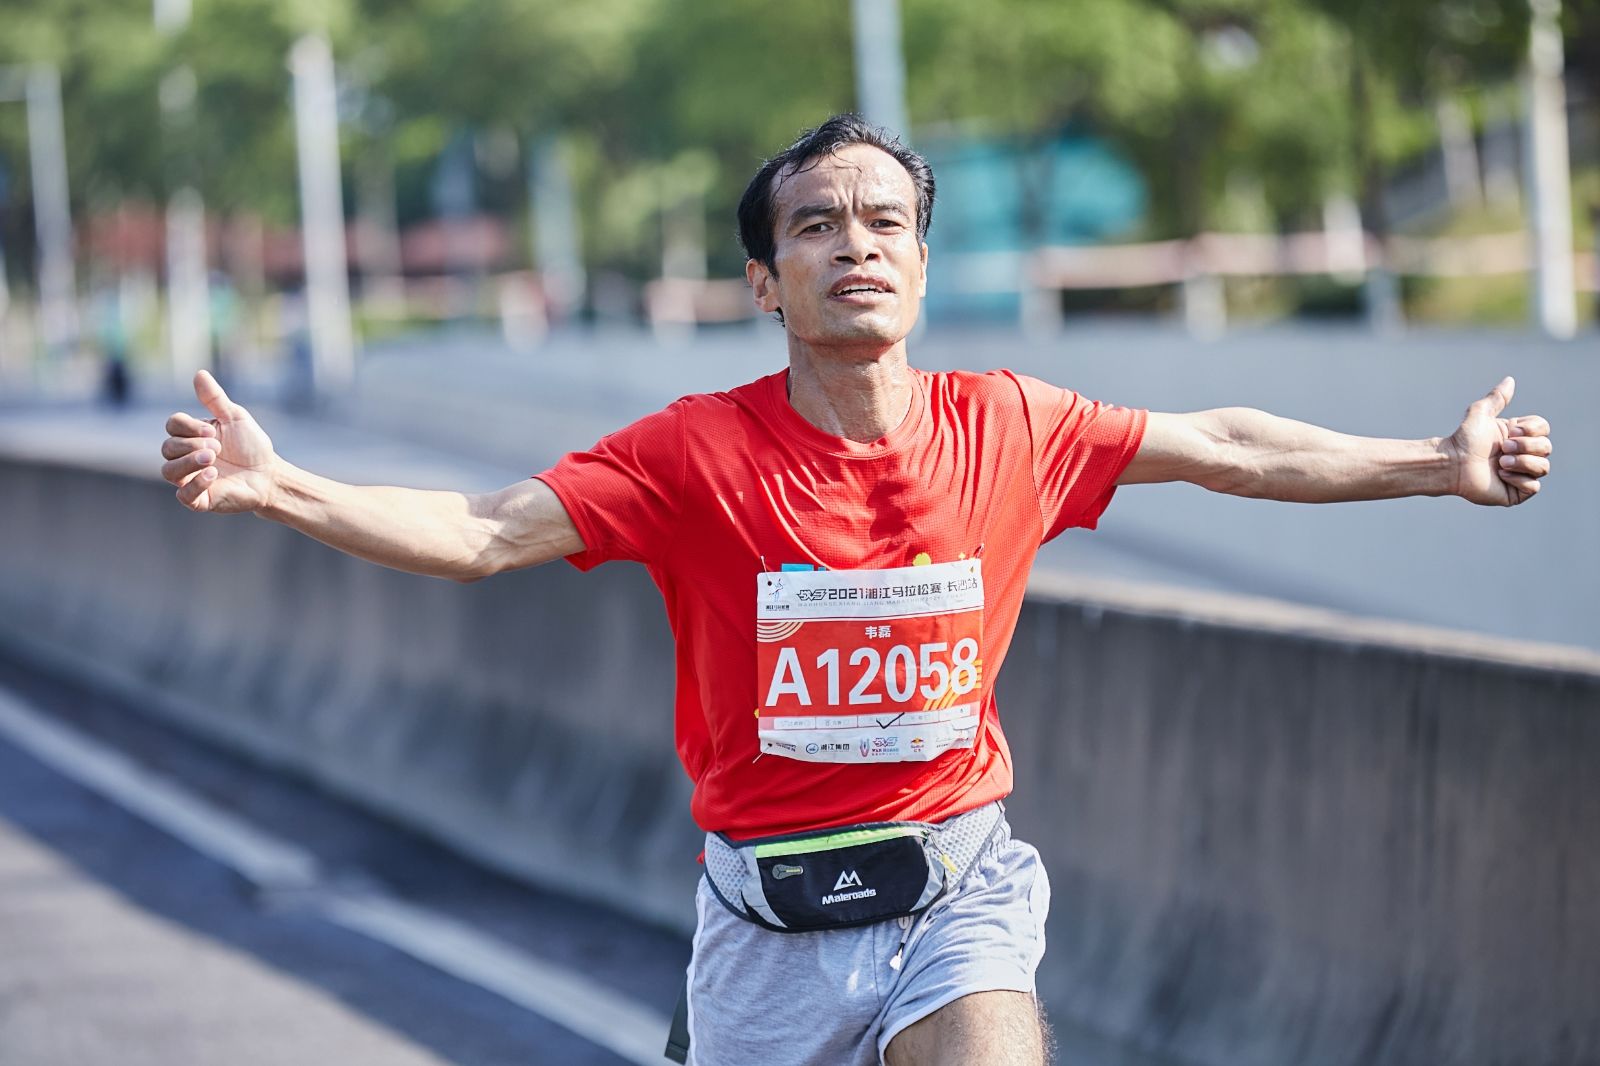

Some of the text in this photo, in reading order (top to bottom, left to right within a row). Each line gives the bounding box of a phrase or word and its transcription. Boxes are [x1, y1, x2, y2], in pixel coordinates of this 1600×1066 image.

[865, 625, 891, 639] 韦磊
[765, 638, 978, 706] A12058
[821, 888, 877, 905] Maleroads
